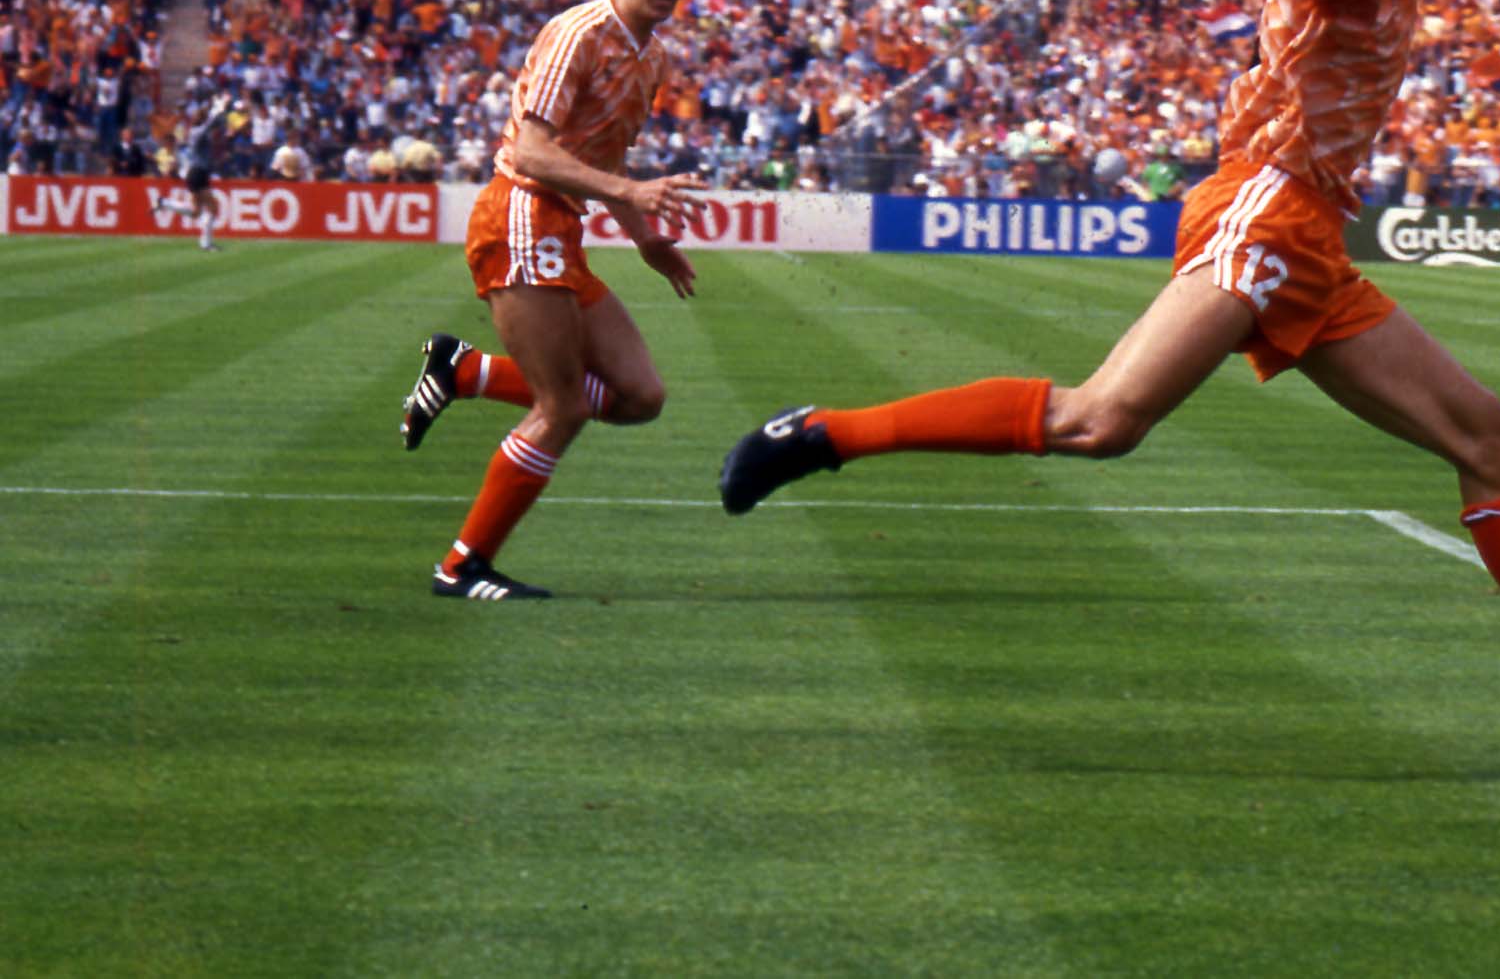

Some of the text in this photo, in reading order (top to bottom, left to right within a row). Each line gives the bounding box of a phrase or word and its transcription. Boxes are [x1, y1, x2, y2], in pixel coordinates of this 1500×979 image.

[15, 184, 119, 226] JVC
[325, 191, 432, 234] JVC
[922, 202, 1151, 253] PHILIPS
[535, 235, 566, 279] 8
[1235, 244, 1289, 312] 12
